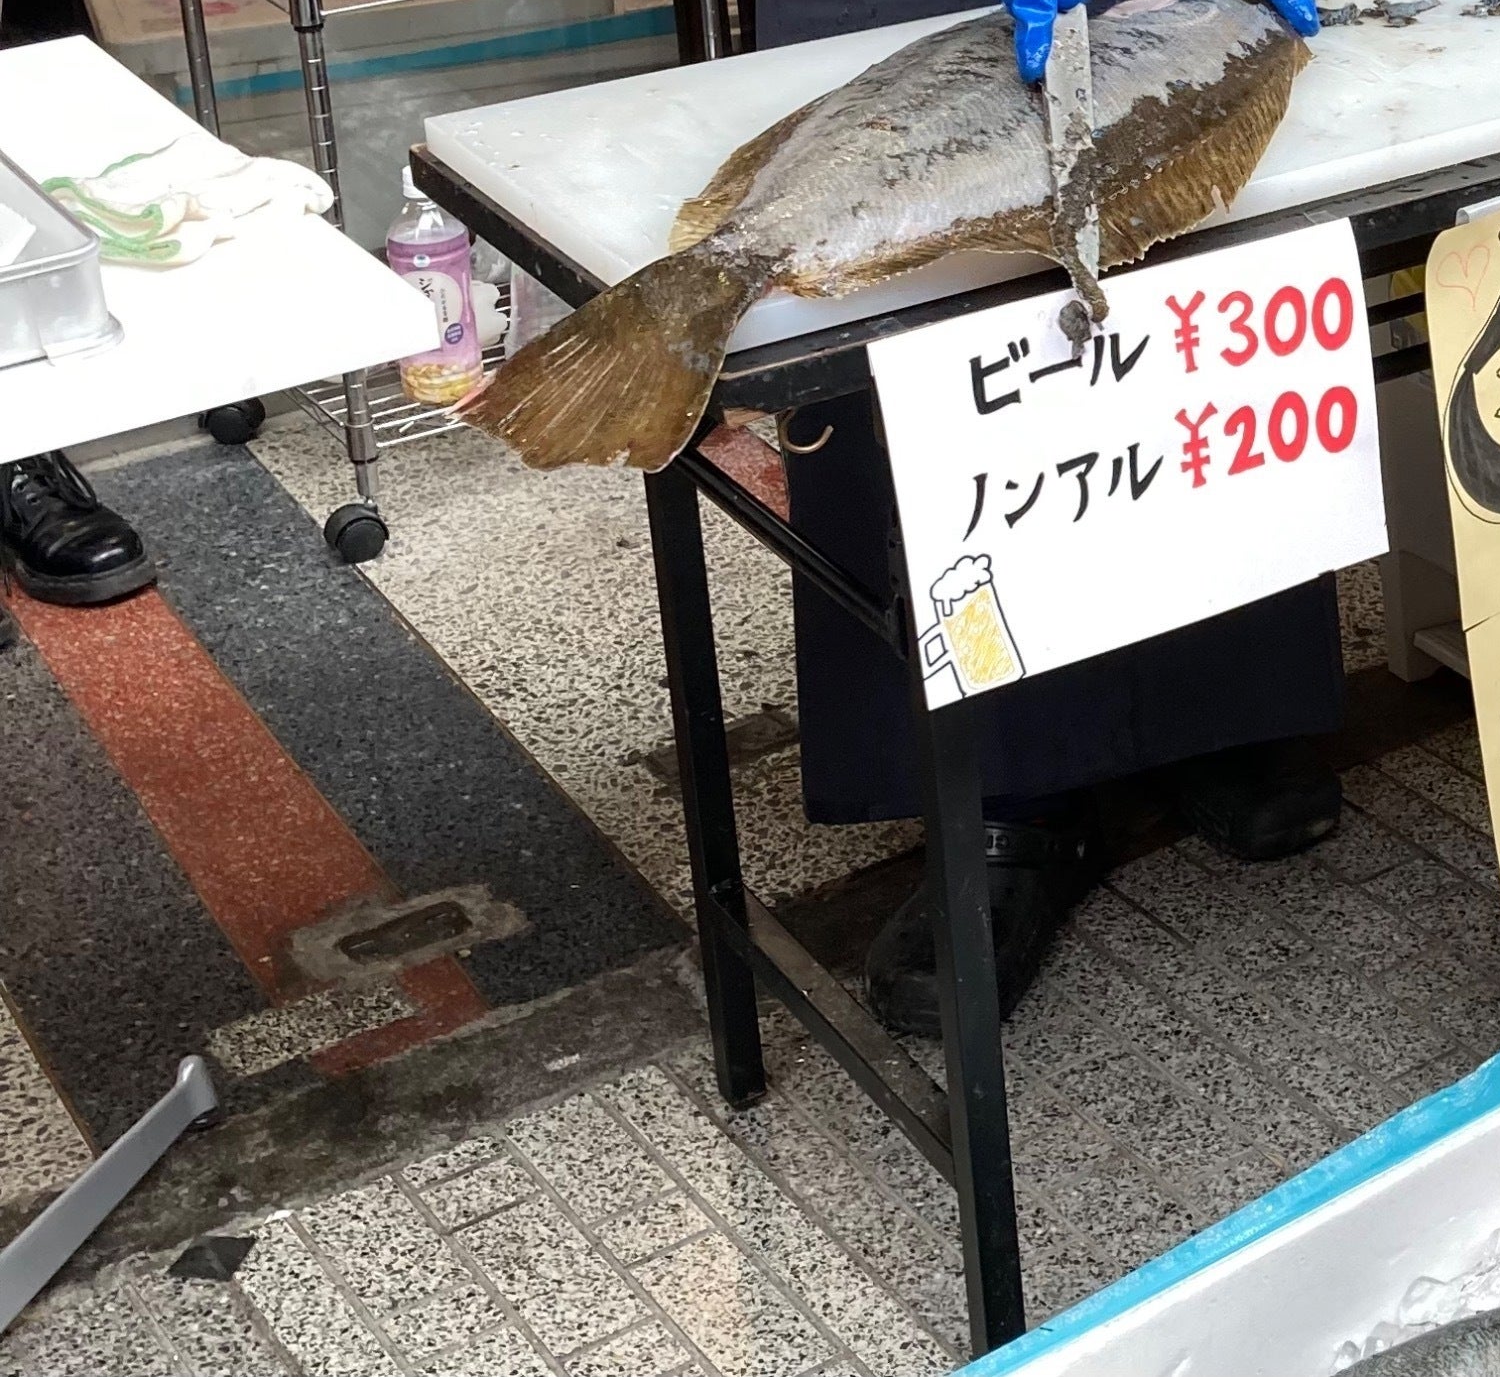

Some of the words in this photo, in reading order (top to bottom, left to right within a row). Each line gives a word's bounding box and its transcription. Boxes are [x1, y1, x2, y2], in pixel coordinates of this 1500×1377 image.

[969, 334, 1151, 415] ビール
[1165, 276, 1354, 373] ¥300
[962, 442, 1164, 542] ノンアル
[1174, 386, 1358, 488] ¥200
